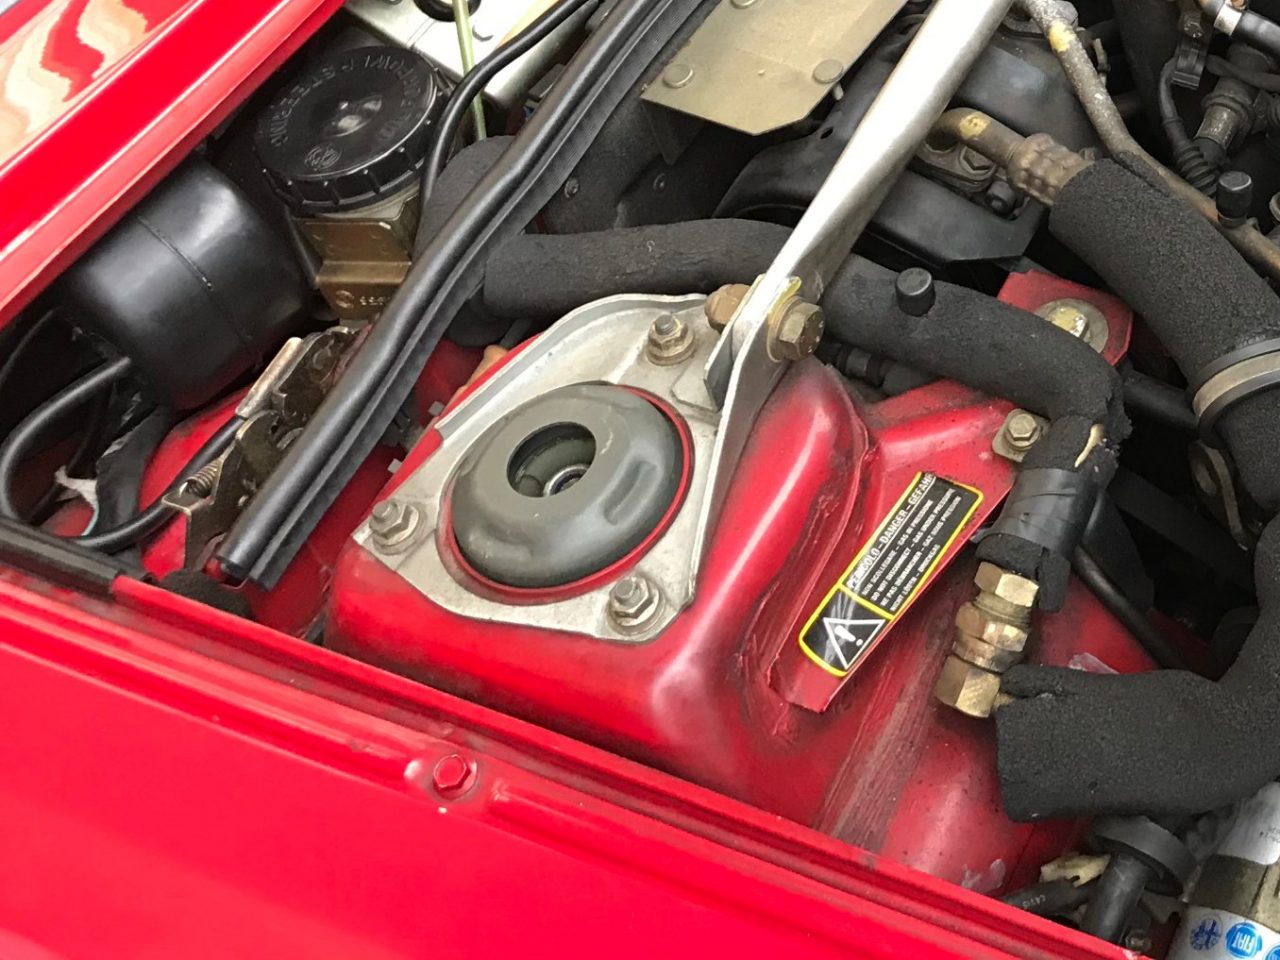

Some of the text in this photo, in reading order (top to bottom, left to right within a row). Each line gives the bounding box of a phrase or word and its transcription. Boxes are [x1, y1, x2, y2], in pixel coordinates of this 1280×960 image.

[847, 547, 879, 588] PERICOLO
[879, 509, 907, 542] DANGER
[886, 585, 896, 597] PAS
[1231, 931, 1256, 952] FIAT
